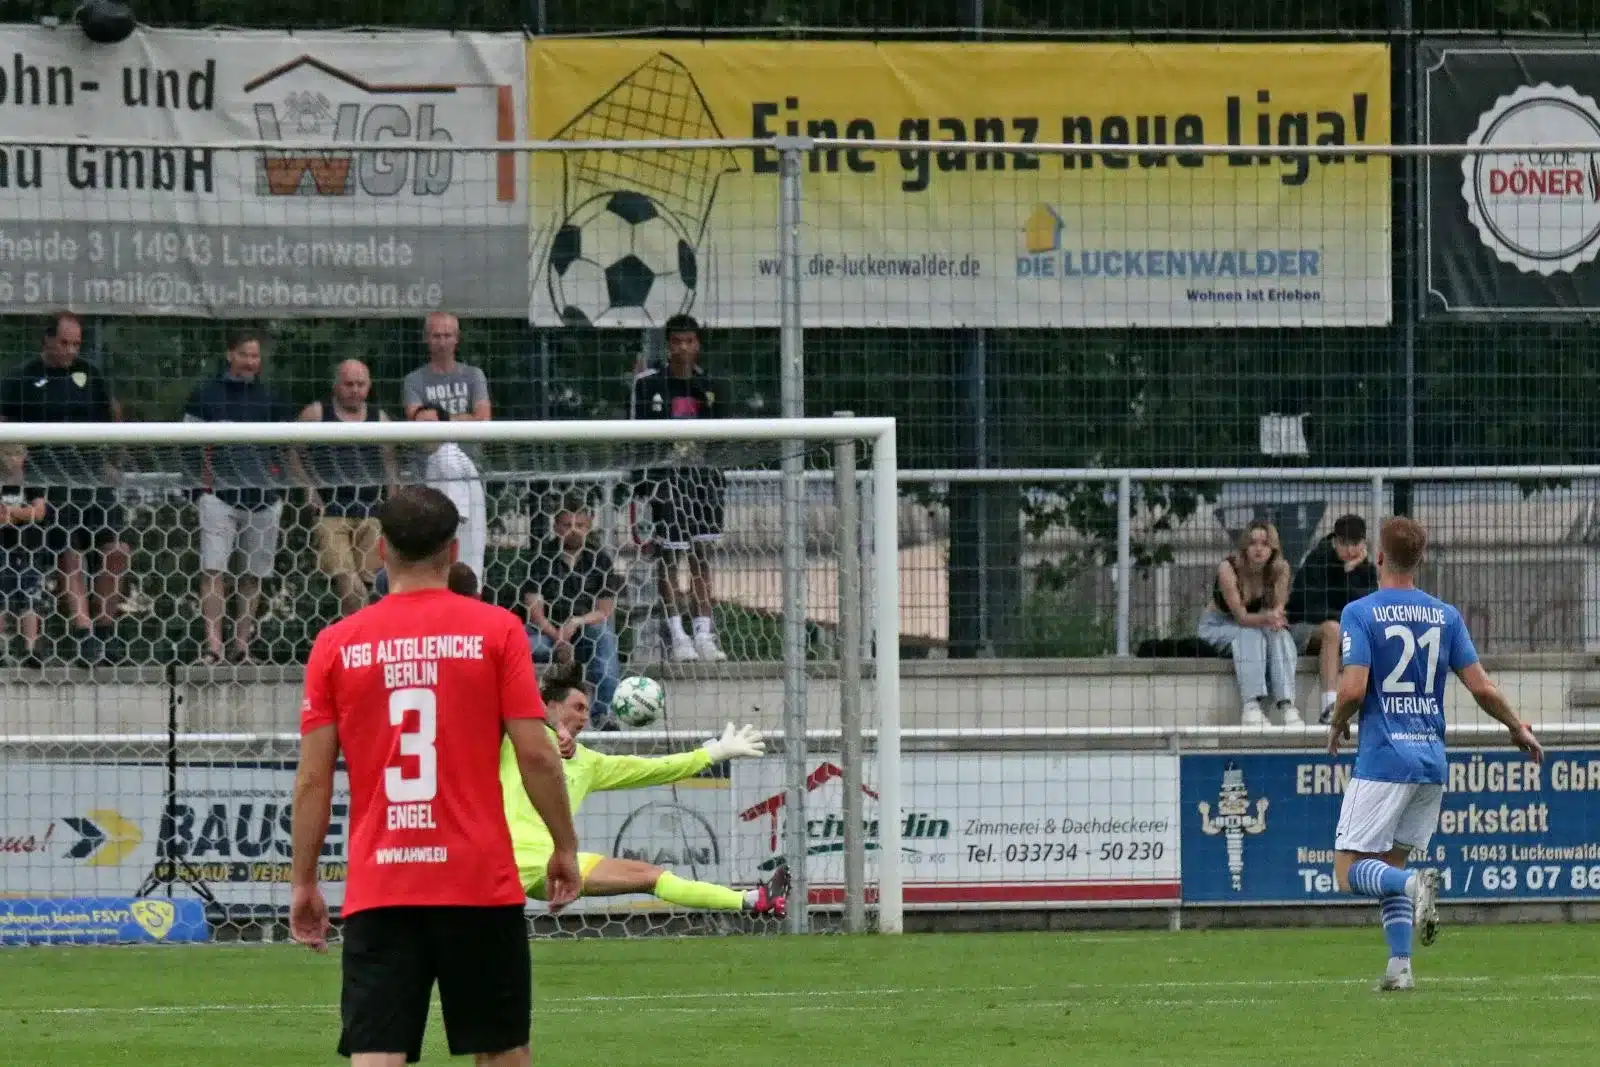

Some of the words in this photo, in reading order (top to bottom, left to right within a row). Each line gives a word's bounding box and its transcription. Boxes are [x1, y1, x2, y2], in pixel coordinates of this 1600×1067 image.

[123, 59, 216, 111] und
[752, 97, 877, 173] Eine
[898, 117, 1040, 191] ganz
[1062, 113, 1204, 169] neue
[1226, 90, 1368, 186] Liga!
[67, 136, 213, 192] GmbH
[1490, 161, 1584, 195] DÖNER
[88, 230, 104, 263] 3
[222, 234, 414, 267] Luckenwalde
[1016, 256, 1055, 277] DIE
[1064, 250, 1320, 277] LUCKENWALDER
[24, 272, 53, 303] 51
[1186, 288, 1242, 301] Wohnen
[1246, 288, 1264, 301] ist
[1268, 288, 1320, 301] Erleben
[1373, 605, 1446, 625] LUCKENWALDE
[340, 643, 373, 669] VSG
[376, 636, 484, 664] ALTGLIENICKE
[1382, 625, 1441, 694] 21
[384, 661, 438, 688] BERLIN
[384, 688, 437, 802] 3
[1446, 757, 1542, 793] RÜGER
[1552, 760, 1600, 792] GbR
[387, 804, 436, 830] ENGEL
[964, 818, 1041, 836] Zimmerei
[1044, 817, 1056, 834] &
[1062, 815, 1169, 834] Dachdeckerei
[1434, 803, 1549, 834] erkstatt
[966, 844, 998, 863] Tel.
[1005, 842, 1078, 863] 033734
[1436, 845, 1446, 862] 6
[1461, 845, 1507, 862] 14943
[1482, 866, 1517, 891] 63
[1526, 866, 1562, 891] 07
